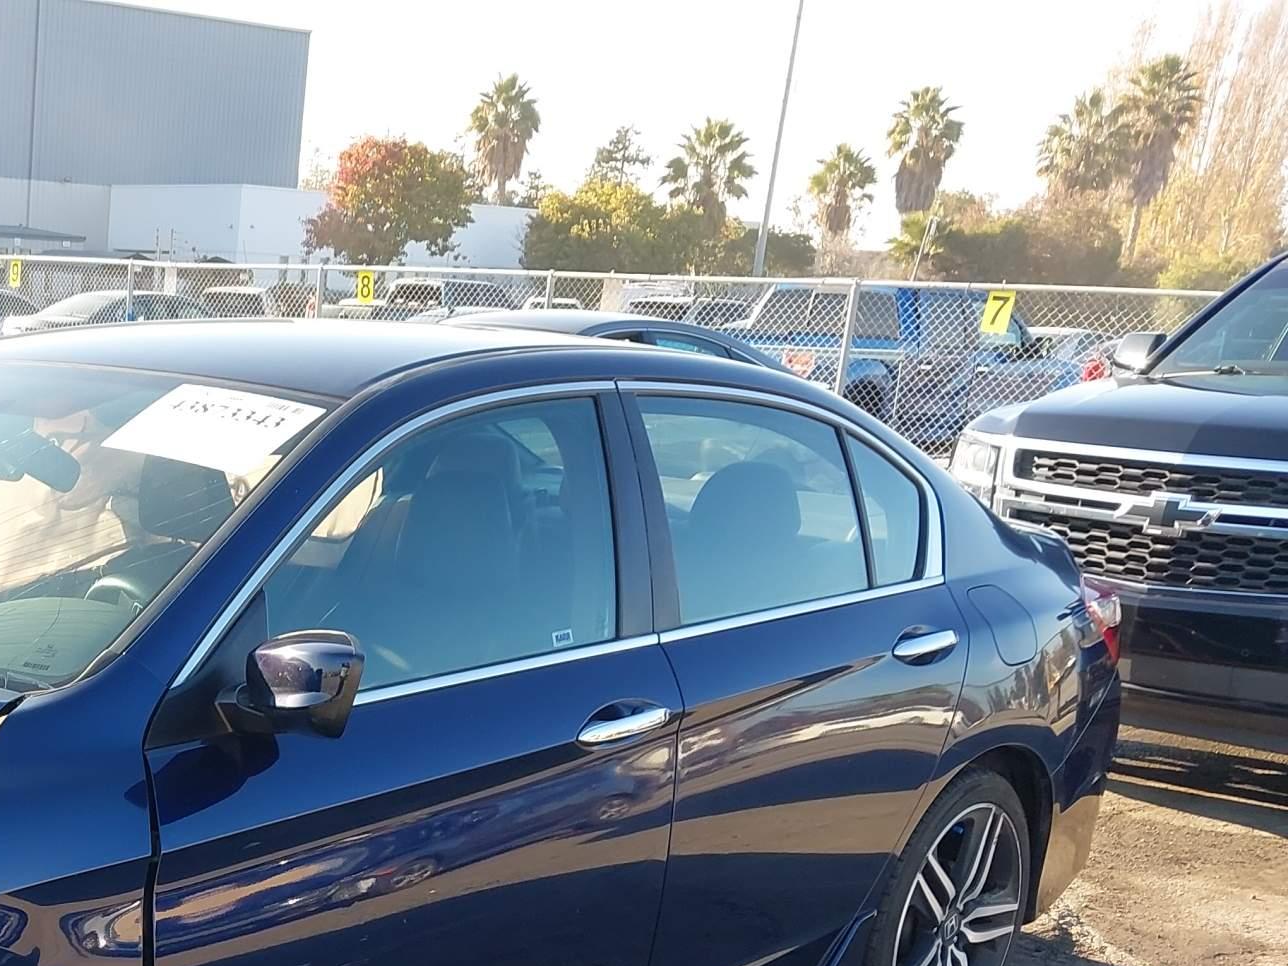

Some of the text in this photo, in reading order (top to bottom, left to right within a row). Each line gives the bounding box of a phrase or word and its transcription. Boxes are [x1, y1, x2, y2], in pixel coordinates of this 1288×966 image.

[12, 263, 19, 282] 9
[361, 275, 371, 298] 8
[990, 295, 1011, 325] 7
